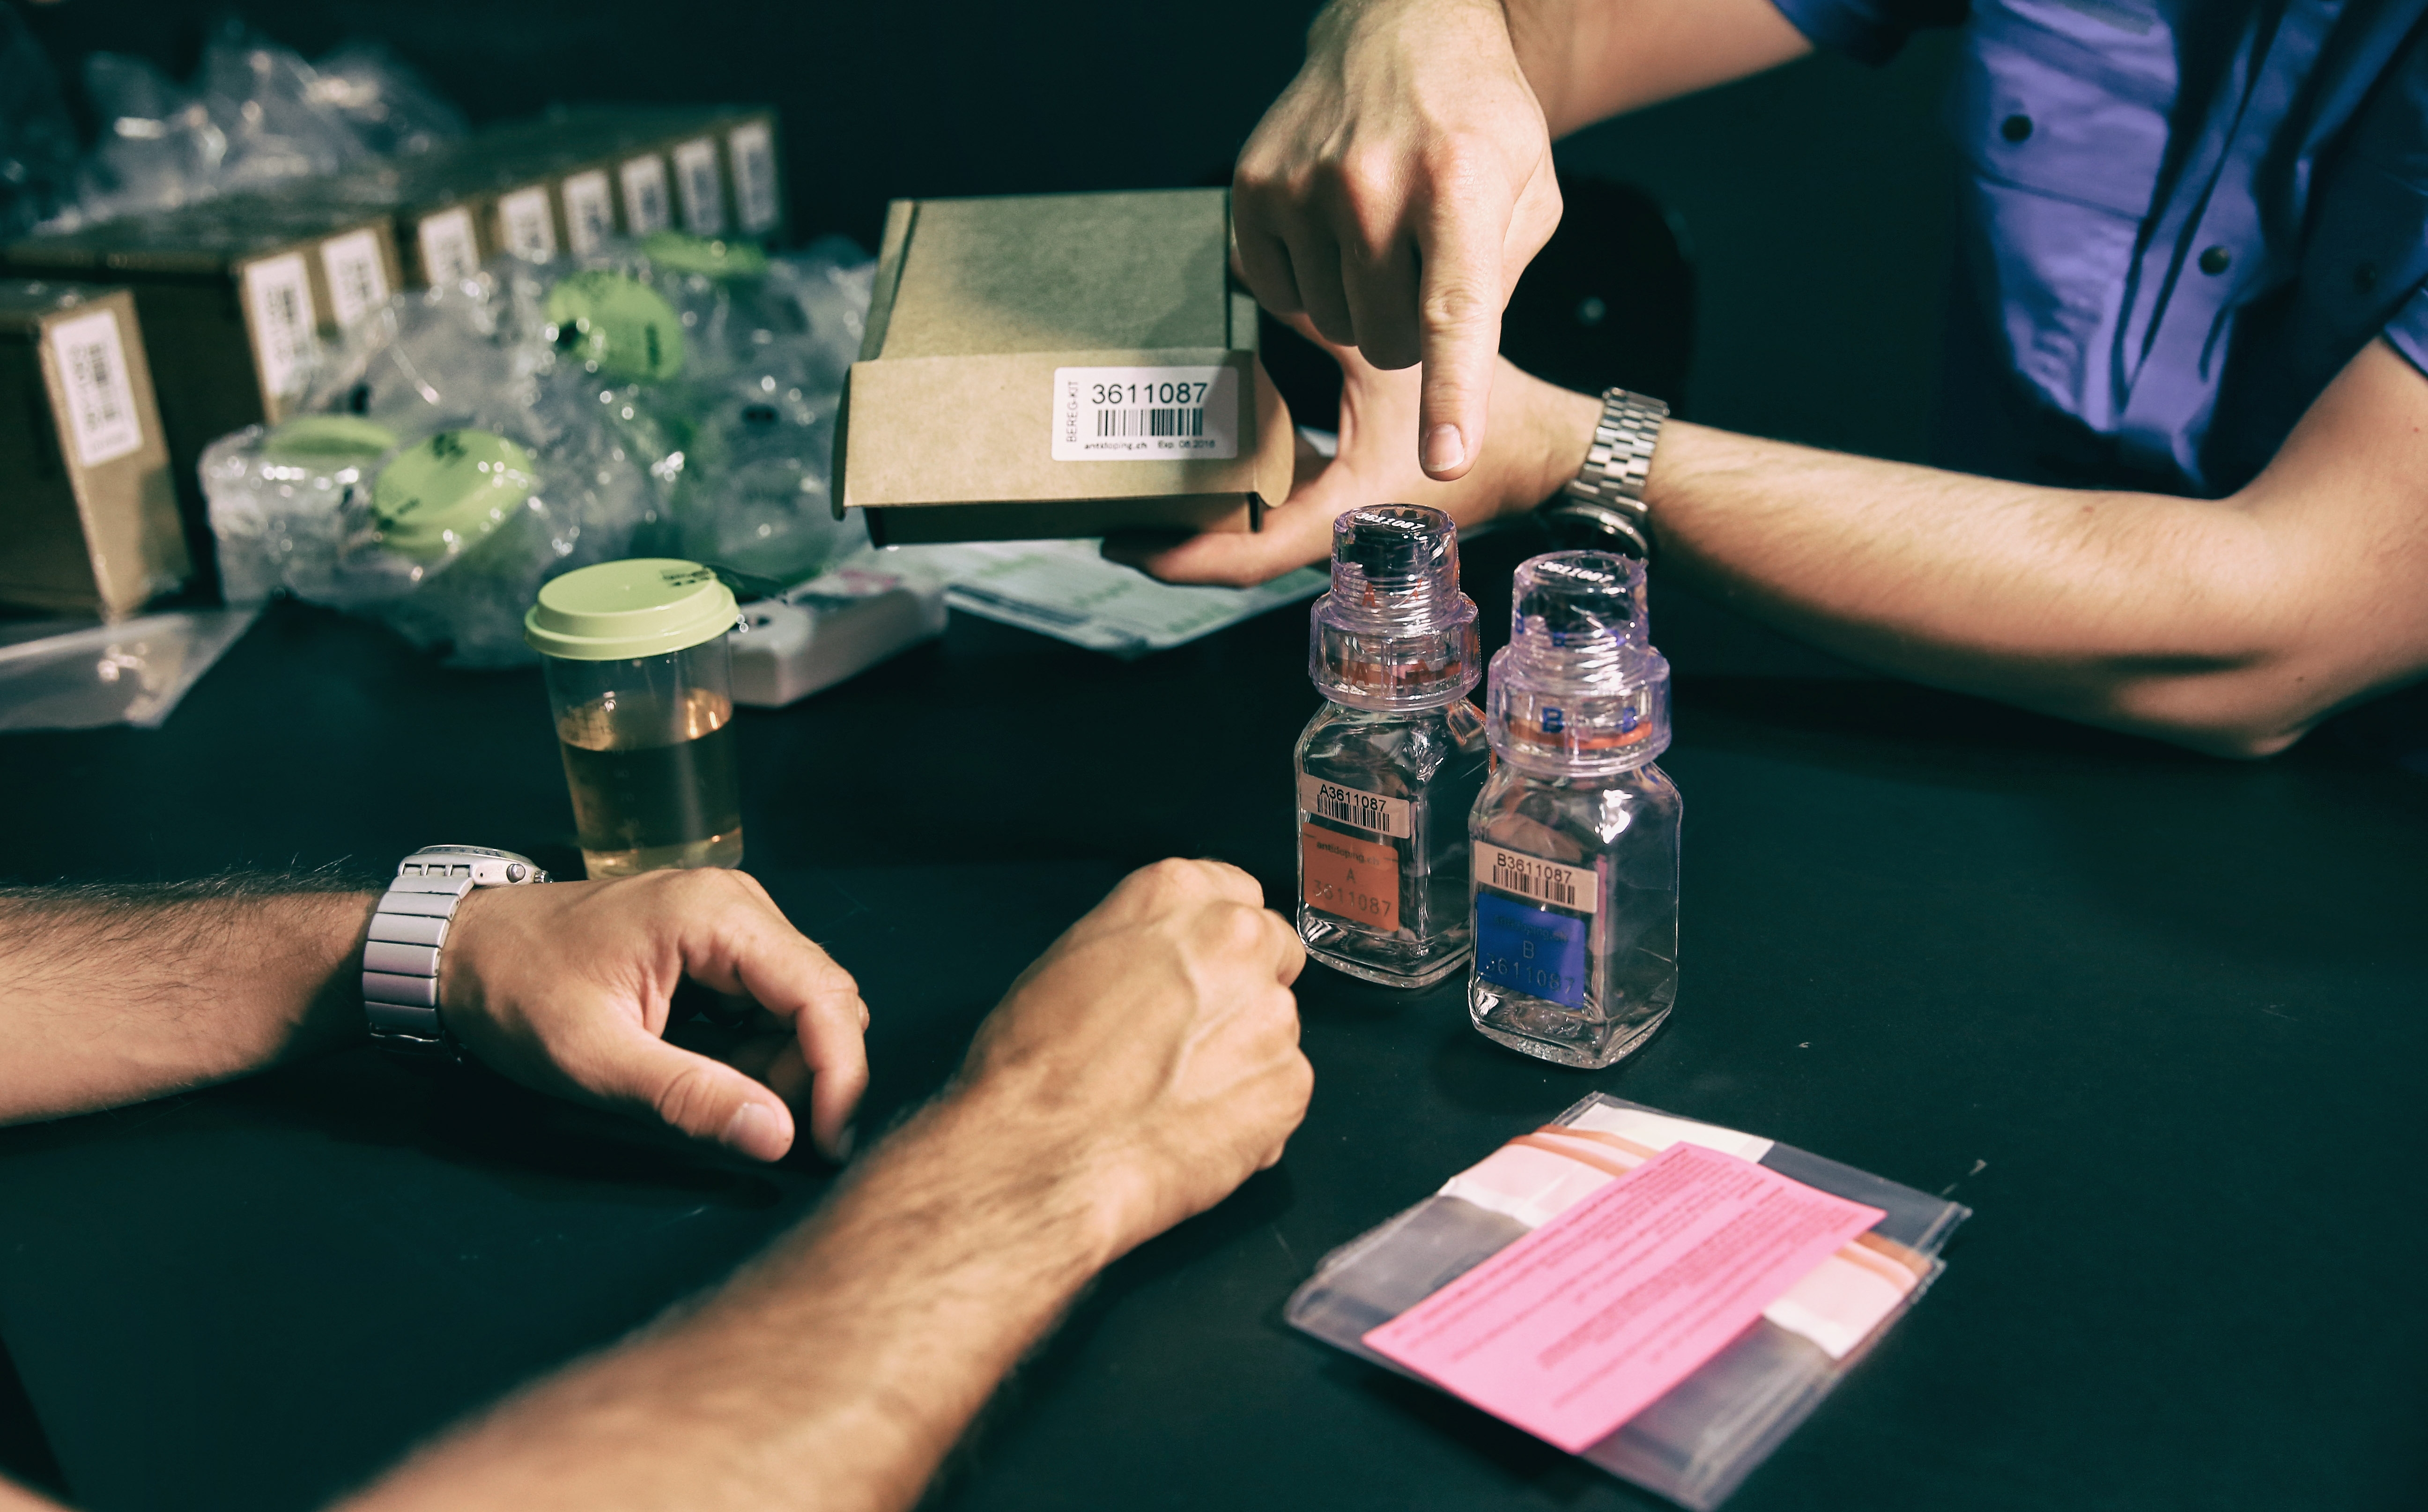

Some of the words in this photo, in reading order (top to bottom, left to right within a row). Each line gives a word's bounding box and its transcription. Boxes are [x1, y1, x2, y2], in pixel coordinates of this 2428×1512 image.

[1092, 382, 1208, 404] 3611087
[1066, 381, 1079, 442] BEREG-KIT
[1355, 513, 1426, 530] 3611087
[1320, 784, 1386, 812] A3611087
[1346, 868, 1356, 883] A
[1497, 853, 1572, 884] B3611087
[1313, 880, 1392, 917] 3611087
[1523, 941, 1535, 959] B
[1487, 953, 1575, 994] 3611087
